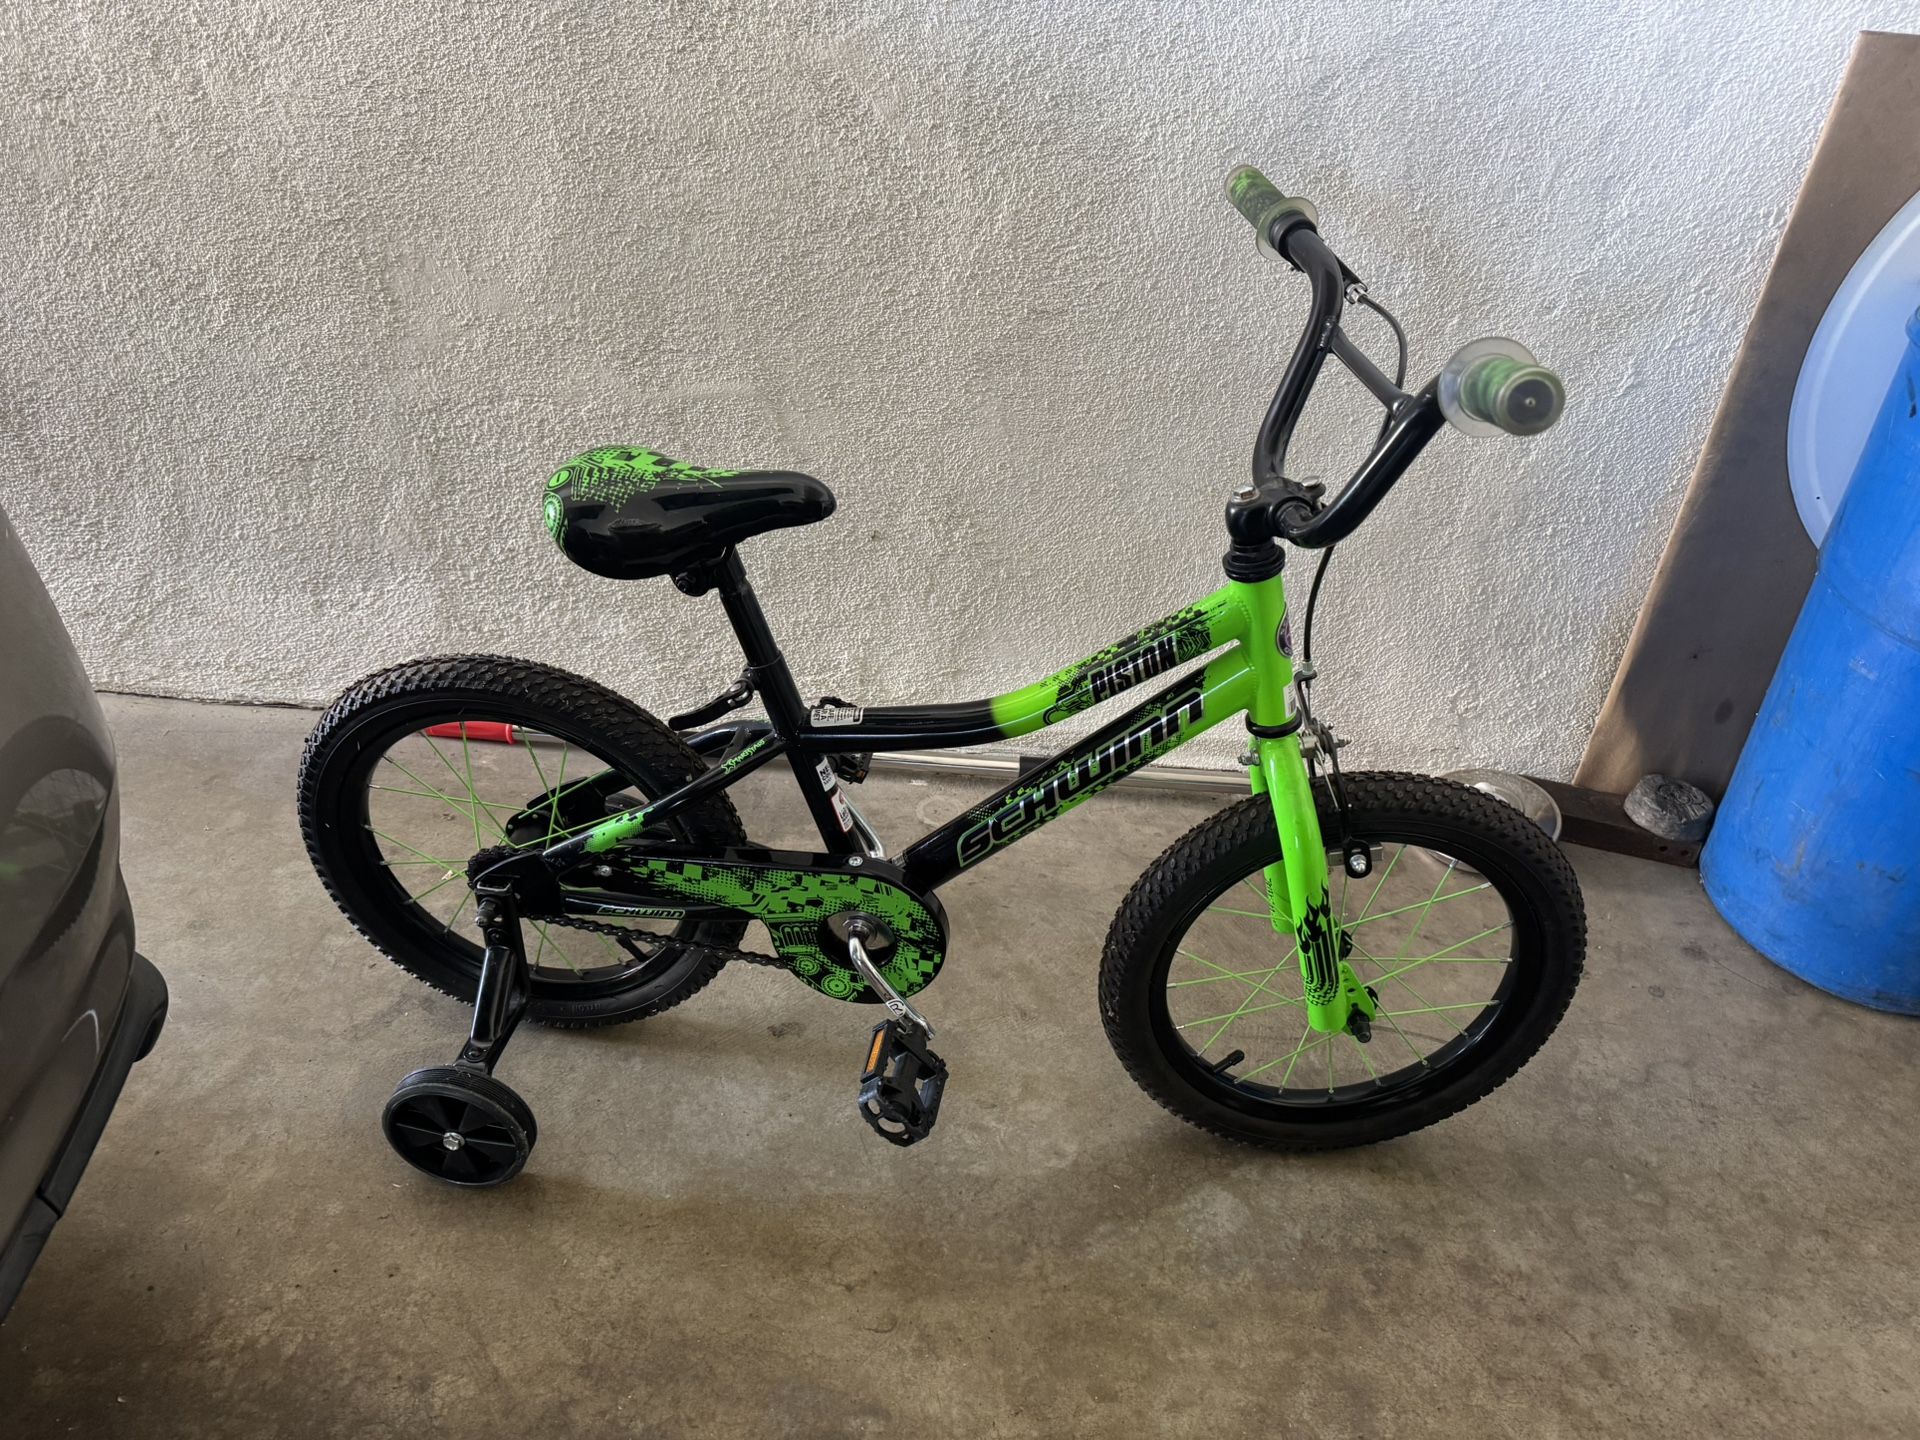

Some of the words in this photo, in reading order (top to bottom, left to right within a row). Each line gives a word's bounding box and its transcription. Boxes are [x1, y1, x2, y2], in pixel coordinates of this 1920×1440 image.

[1088, 634, 1179, 703] PISTON
[957, 687, 1204, 867] SCHWINN
[597, 904, 686, 919] SCHWINN
